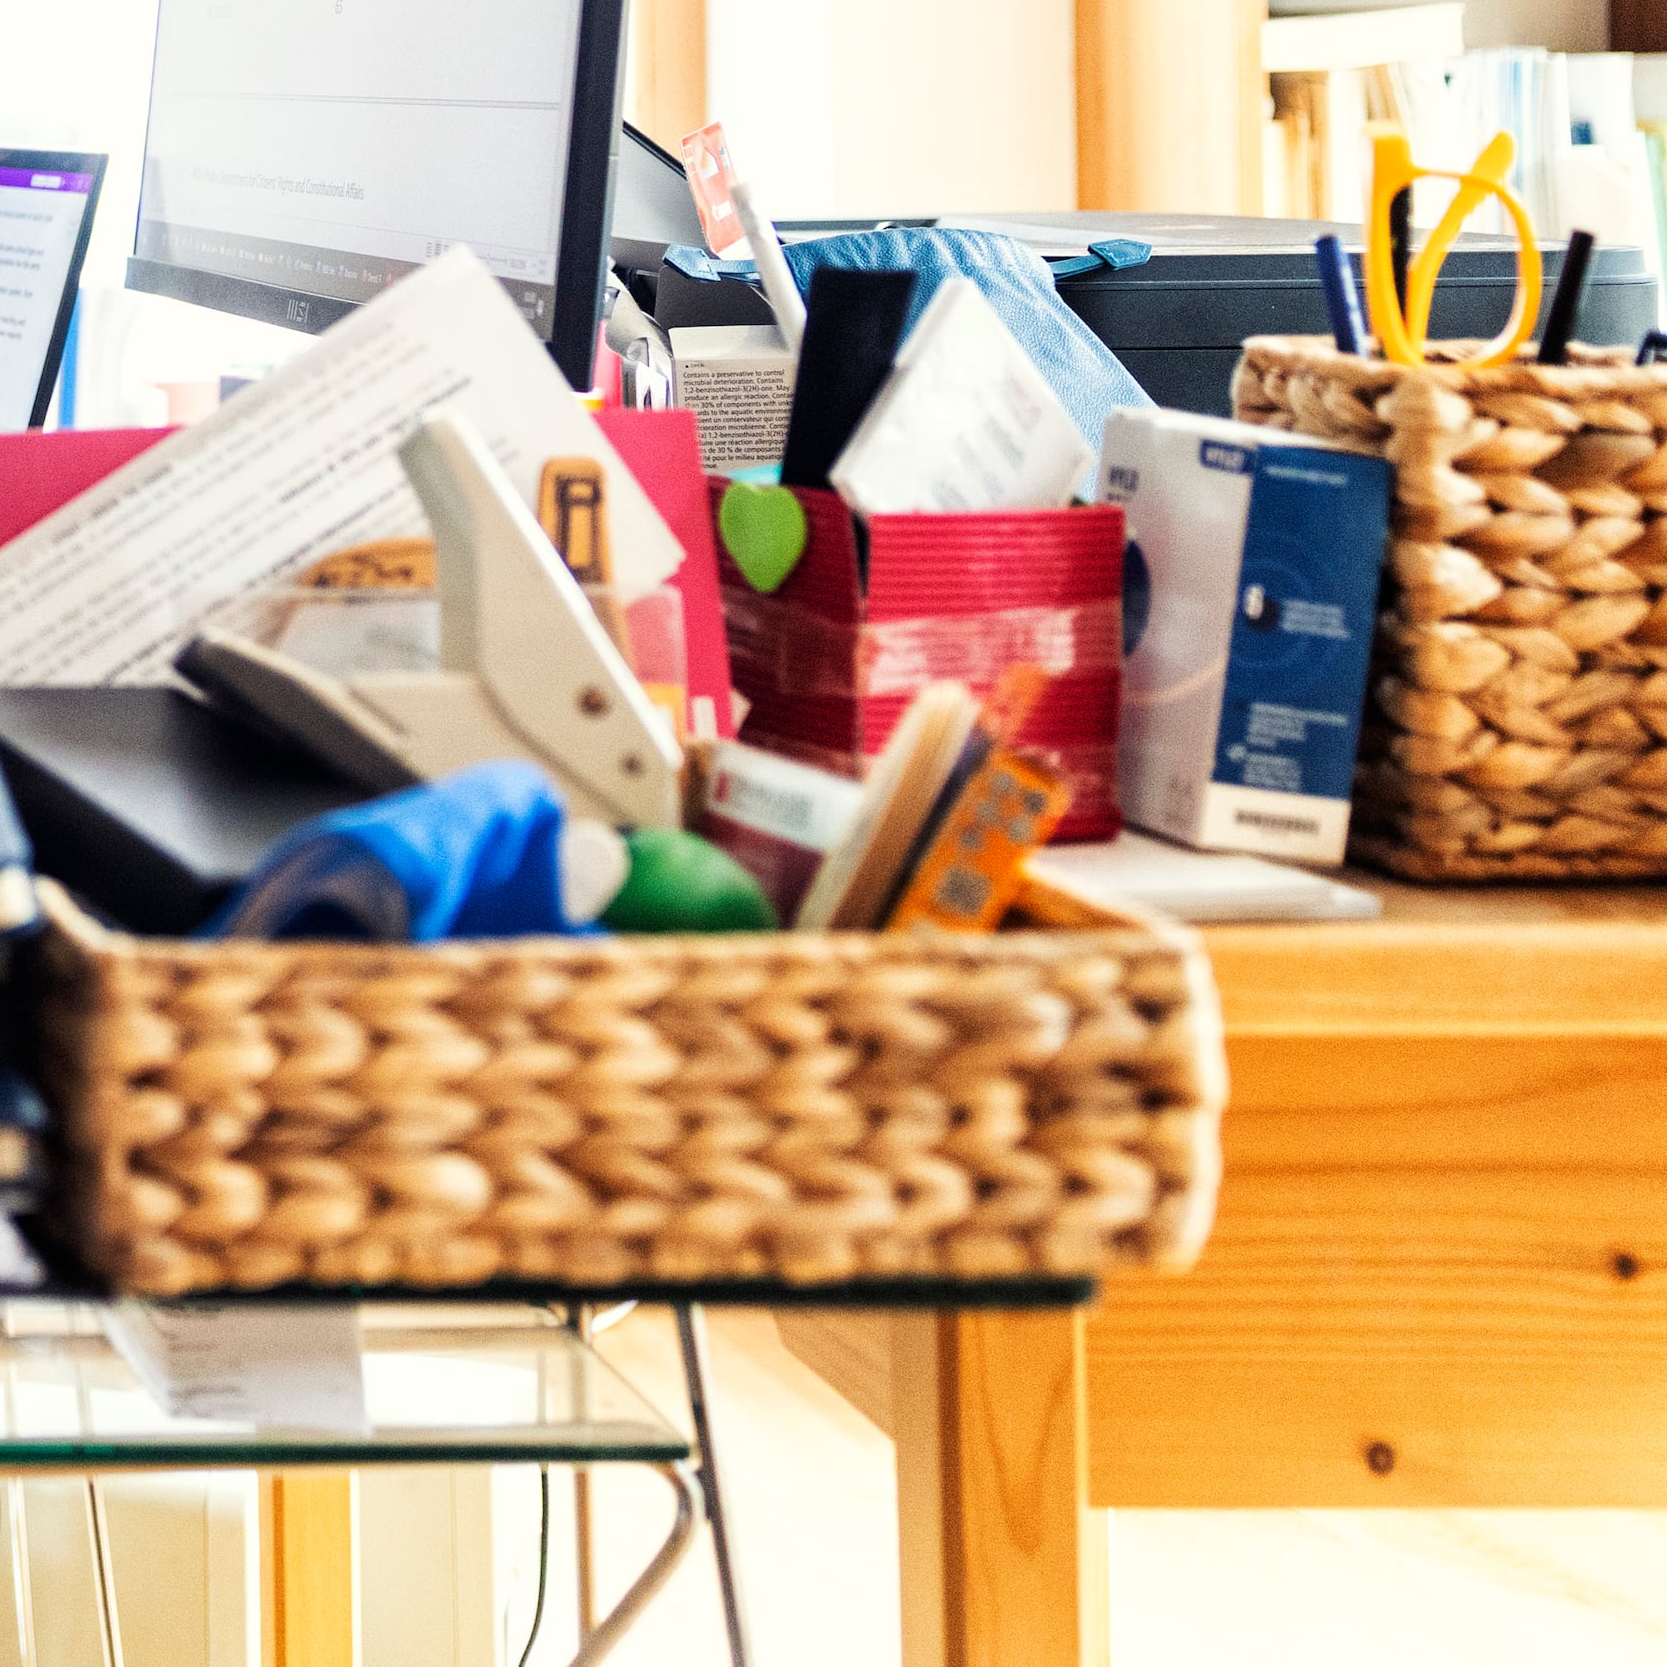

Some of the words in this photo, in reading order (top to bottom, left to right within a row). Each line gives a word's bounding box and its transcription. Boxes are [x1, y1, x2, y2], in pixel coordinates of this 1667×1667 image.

[278, 175, 295, 196] Rights
[294, 177, 306, 194] and
[306, 177, 347, 198] Constitutional
[346, 181, 365, 201] Affairs
[683, 371, 710, 379] Contains
[716, 371, 754, 379] preservative
[683, 378, 712, 386] microbial
[730, 408, 753, 416] aquatic
[727, 423, 767, 431] microbienne.
[744, 445, 781, 453] composants
